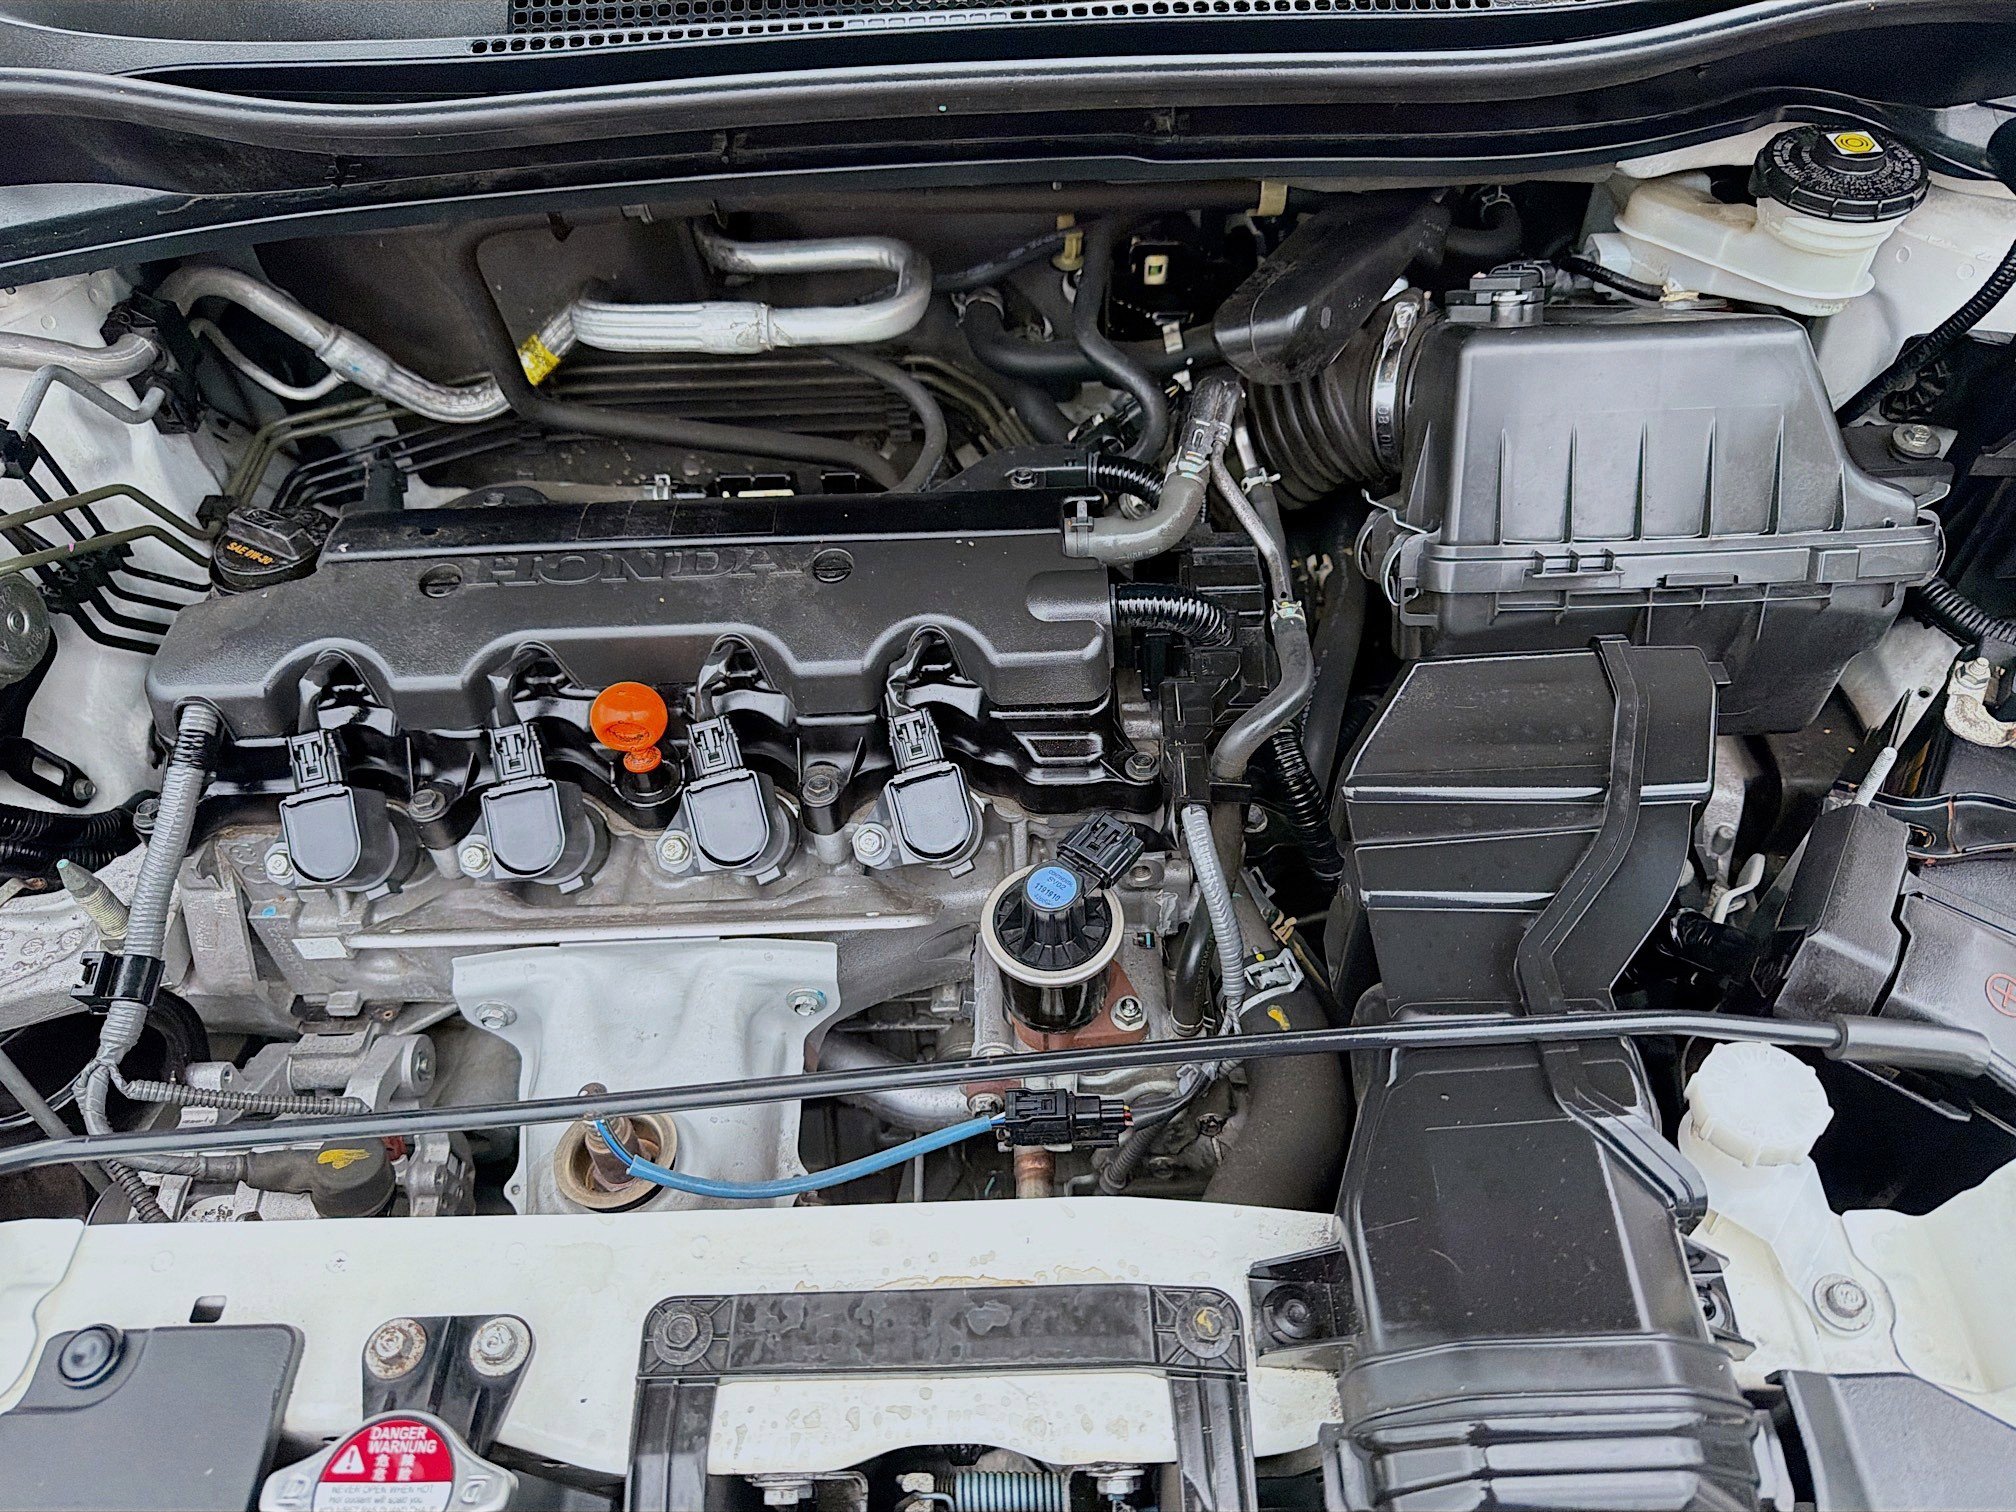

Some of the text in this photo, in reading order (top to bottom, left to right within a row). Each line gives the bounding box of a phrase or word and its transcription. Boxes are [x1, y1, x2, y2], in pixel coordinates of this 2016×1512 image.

[226, 542, 273, 565] SAE 0W-20
[467, 548, 803, 587] HONDA
[369, 1426, 428, 1440] DANGER
[368, 1439, 437, 1454] WARNUNG
[332, 1485, 361, 1494] NEVER
[363, 1485, 386, 1494] OPEN
[390, 1485, 415, 1494] WHEN
